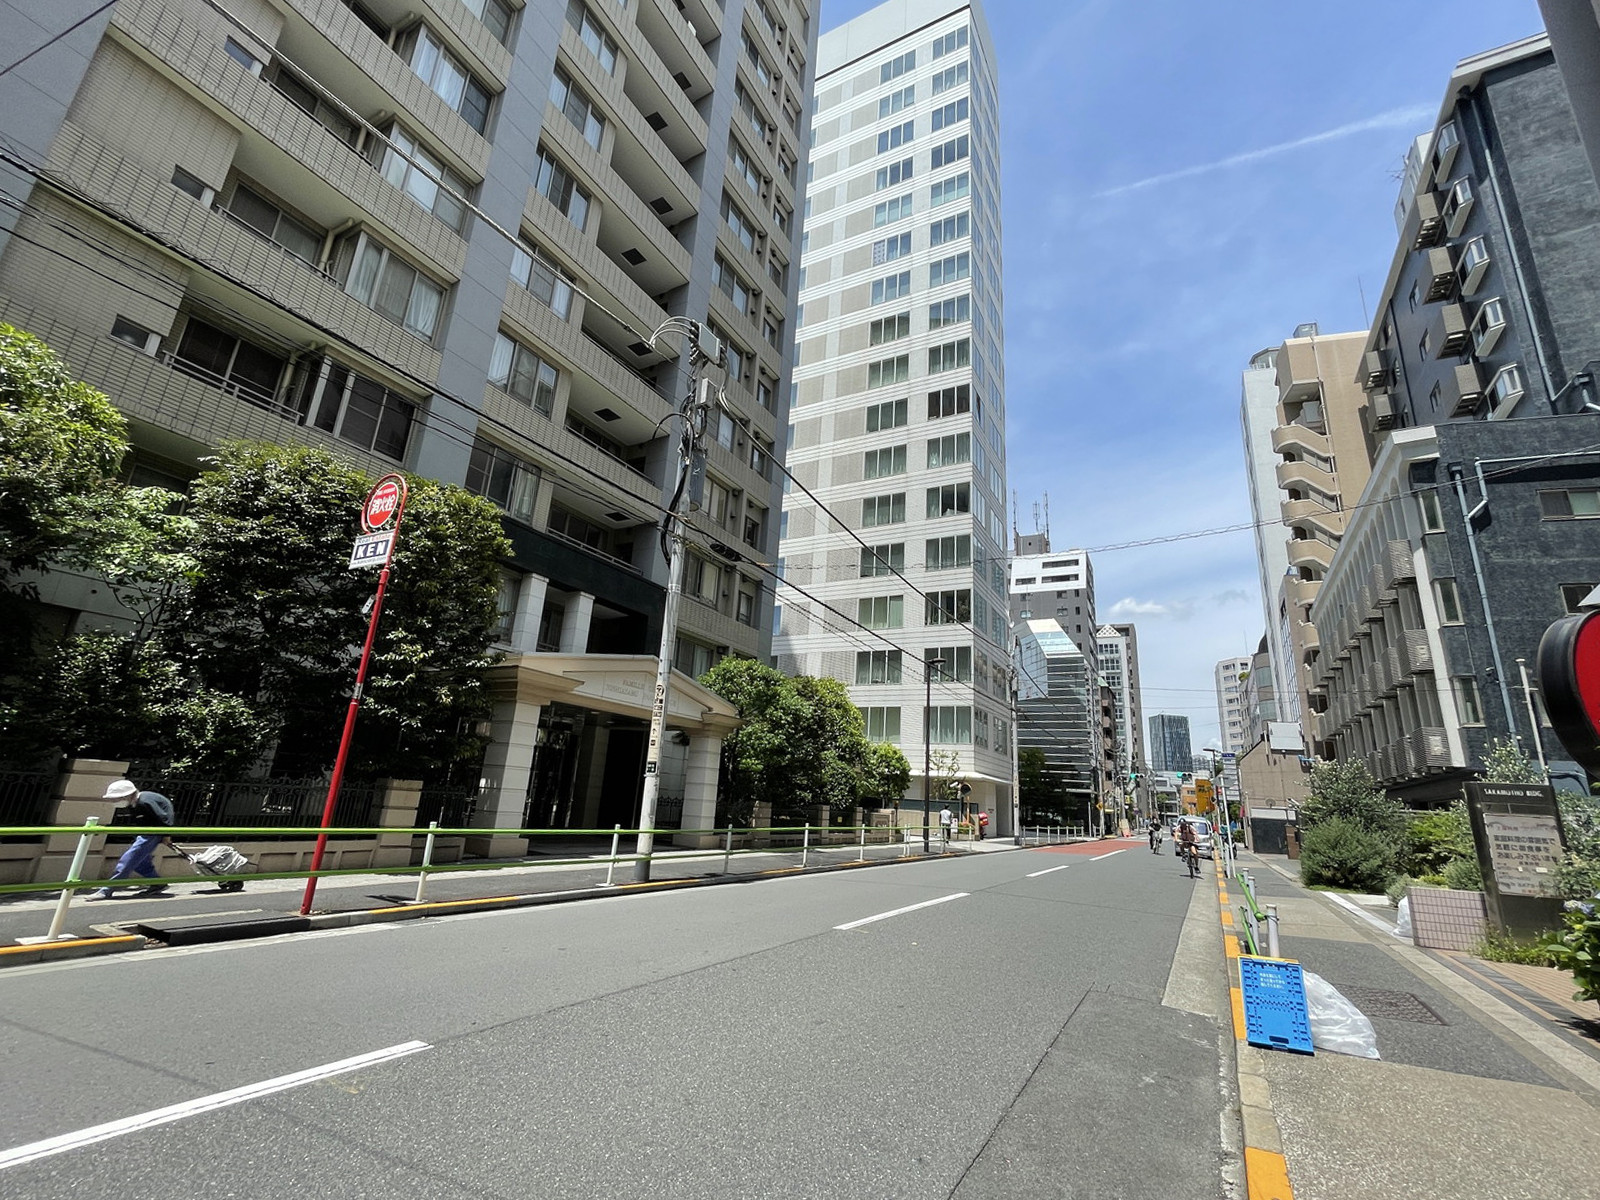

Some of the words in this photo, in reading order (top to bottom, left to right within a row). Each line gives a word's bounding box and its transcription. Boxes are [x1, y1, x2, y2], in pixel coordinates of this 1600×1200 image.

[370, 494, 396, 515] 消火栓
[356, 540, 386, 559] KEN
